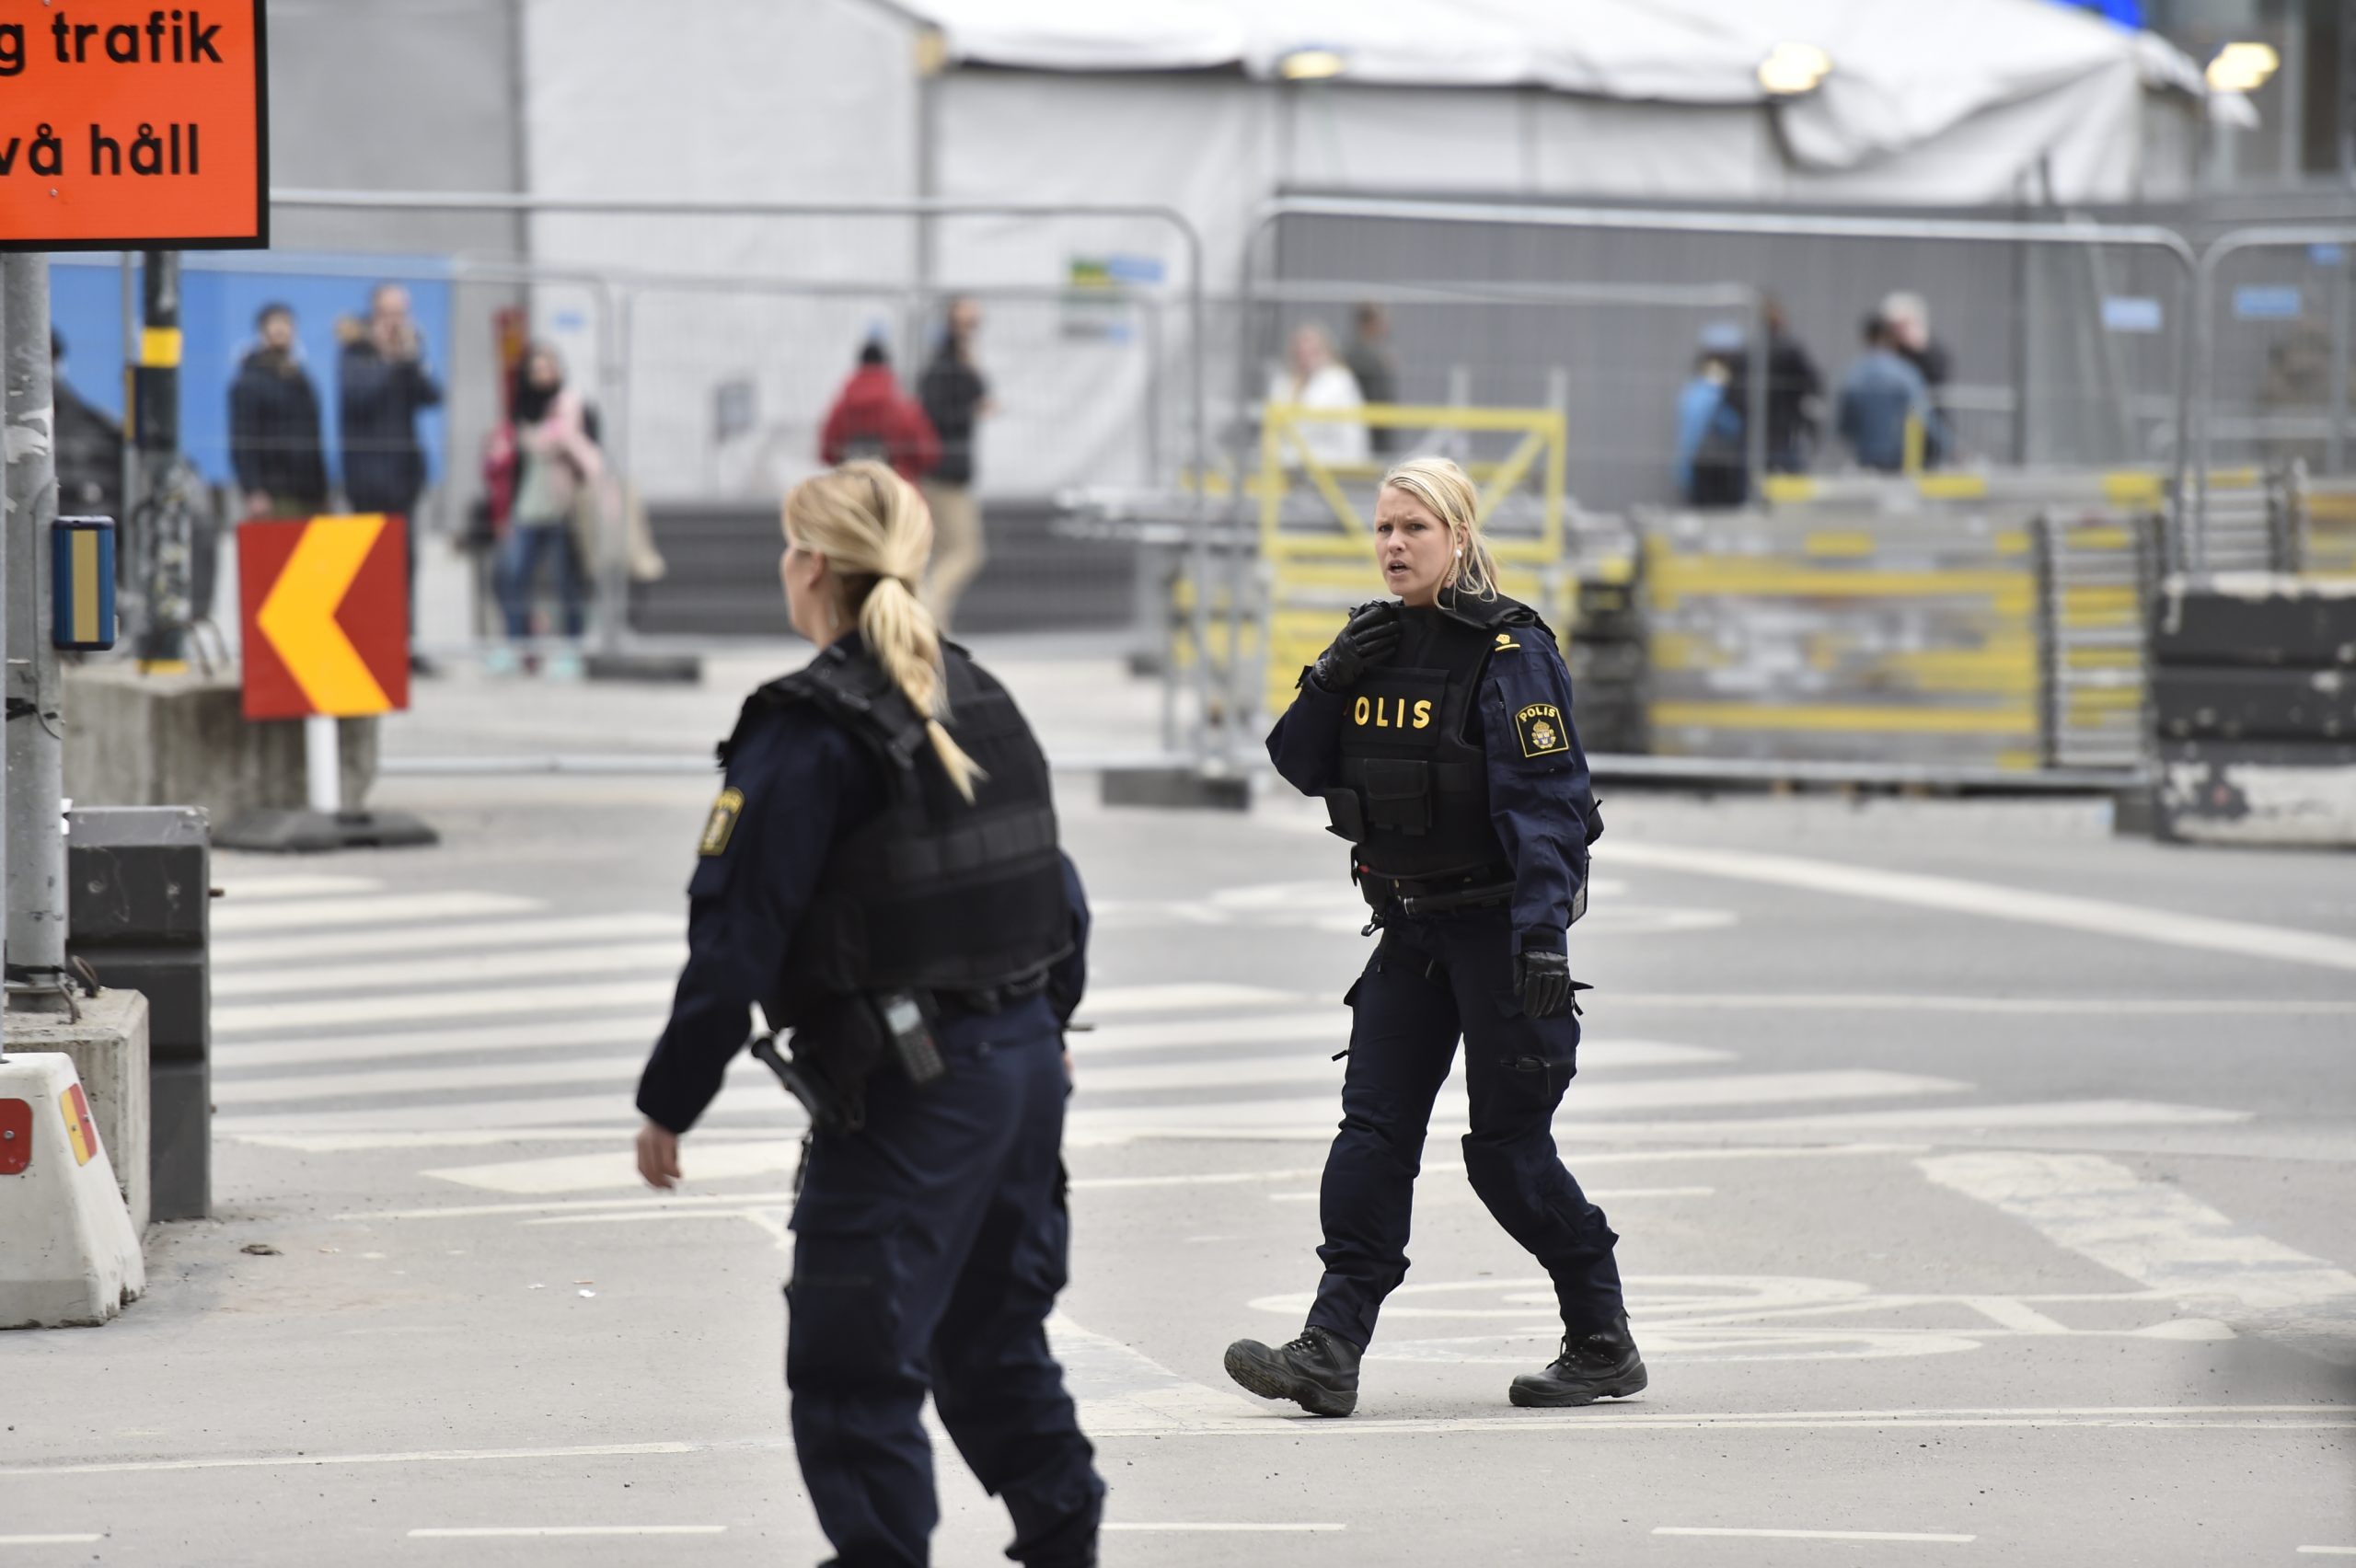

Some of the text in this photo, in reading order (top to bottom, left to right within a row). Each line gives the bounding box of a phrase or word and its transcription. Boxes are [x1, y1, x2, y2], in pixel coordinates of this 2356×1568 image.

[52, 10, 223, 63] trafik
[90, 123, 199, 176] håll
[1345, 697, 1431, 729] OLIS
[1519, 707, 1556, 722] POLIS
